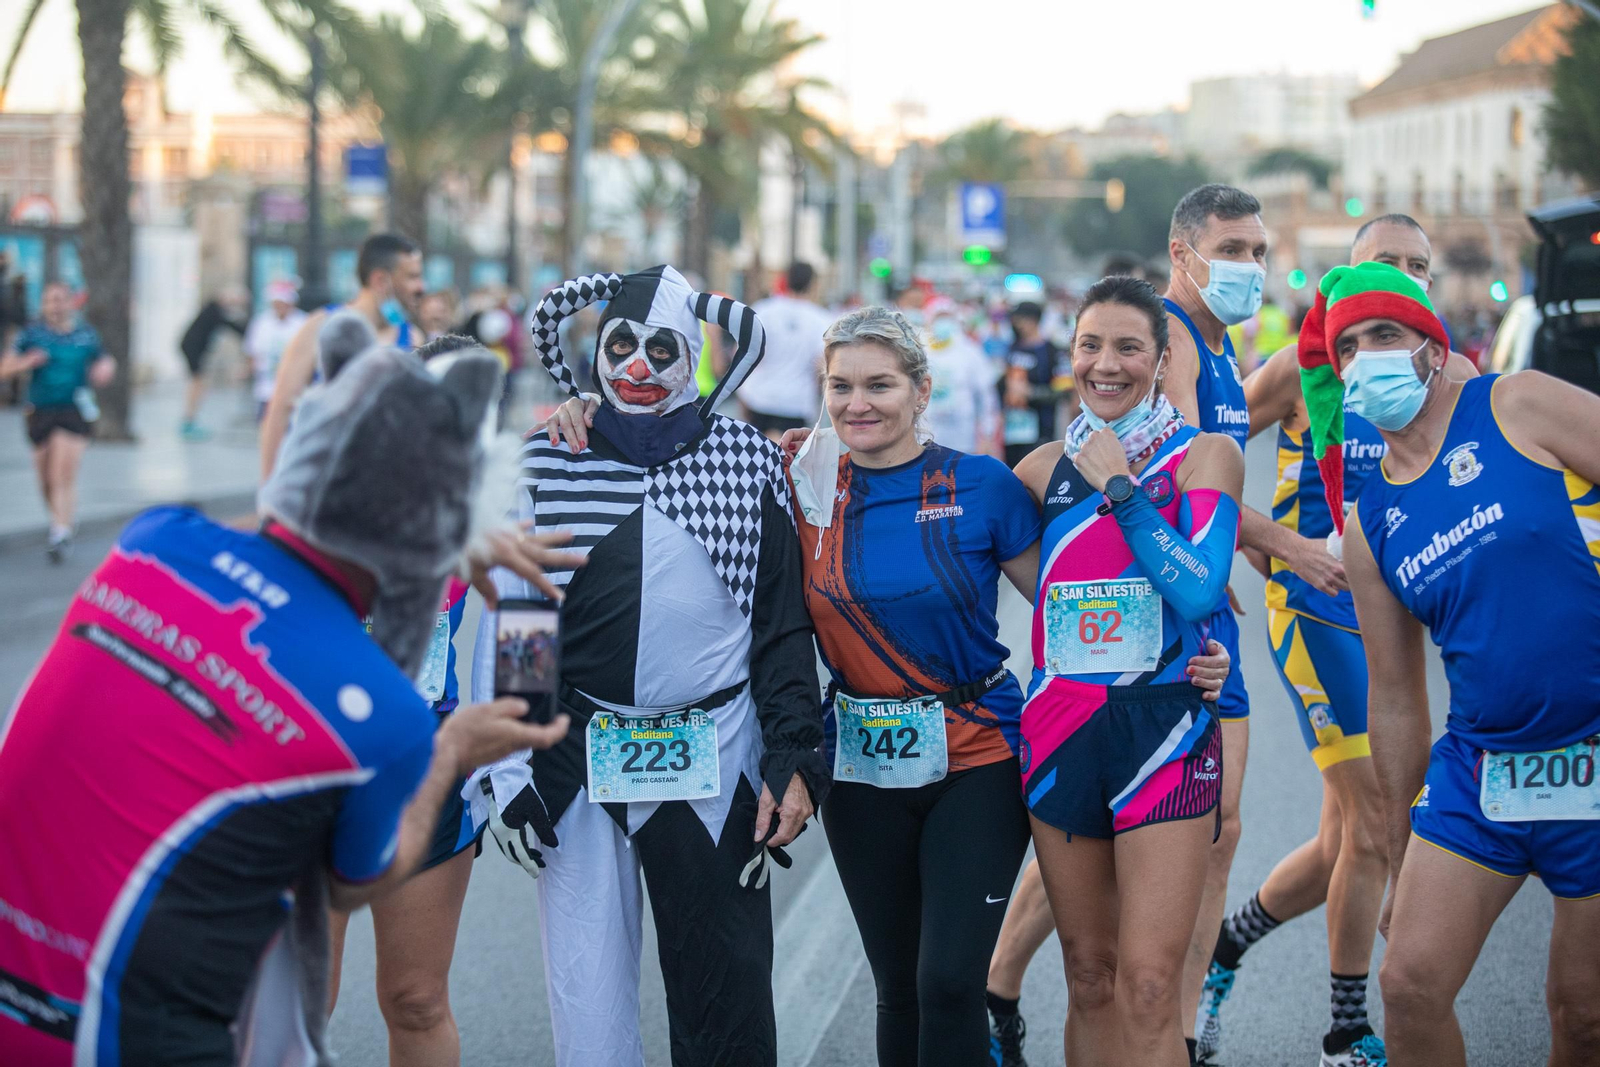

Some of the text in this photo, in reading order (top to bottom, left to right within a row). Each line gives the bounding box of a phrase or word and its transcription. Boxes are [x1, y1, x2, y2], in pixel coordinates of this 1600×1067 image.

[1151, 528, 1176, 552] Páez
[1396, 502, 1504, 589] Tirabuzón
[1478, 531, 1498, 546] 1982
[1160, 560, 1180, 583] C.A.
[1061, 587, 1084, 600] SAN
[1086, 584, 1153, 599] SILVESTRE
[1078, 600, 1118, 609] Gaditana
[1078, 610, 1123, 644] 62
[196, 652, 306, 745] SPORT
[848, 702, 866, 717] SAN
[641, 714, 708, 730] SIVESTRE
[862, 717, 902, 728] Gaditana
[631, 730, 674, 740] Gaditana
[858, 727, 921, 760] 242
[620, 740, 692, 773] 223
[649, 776, 679, 784] CASTAÑO
[1503, 754, 1595, 789] 1200
